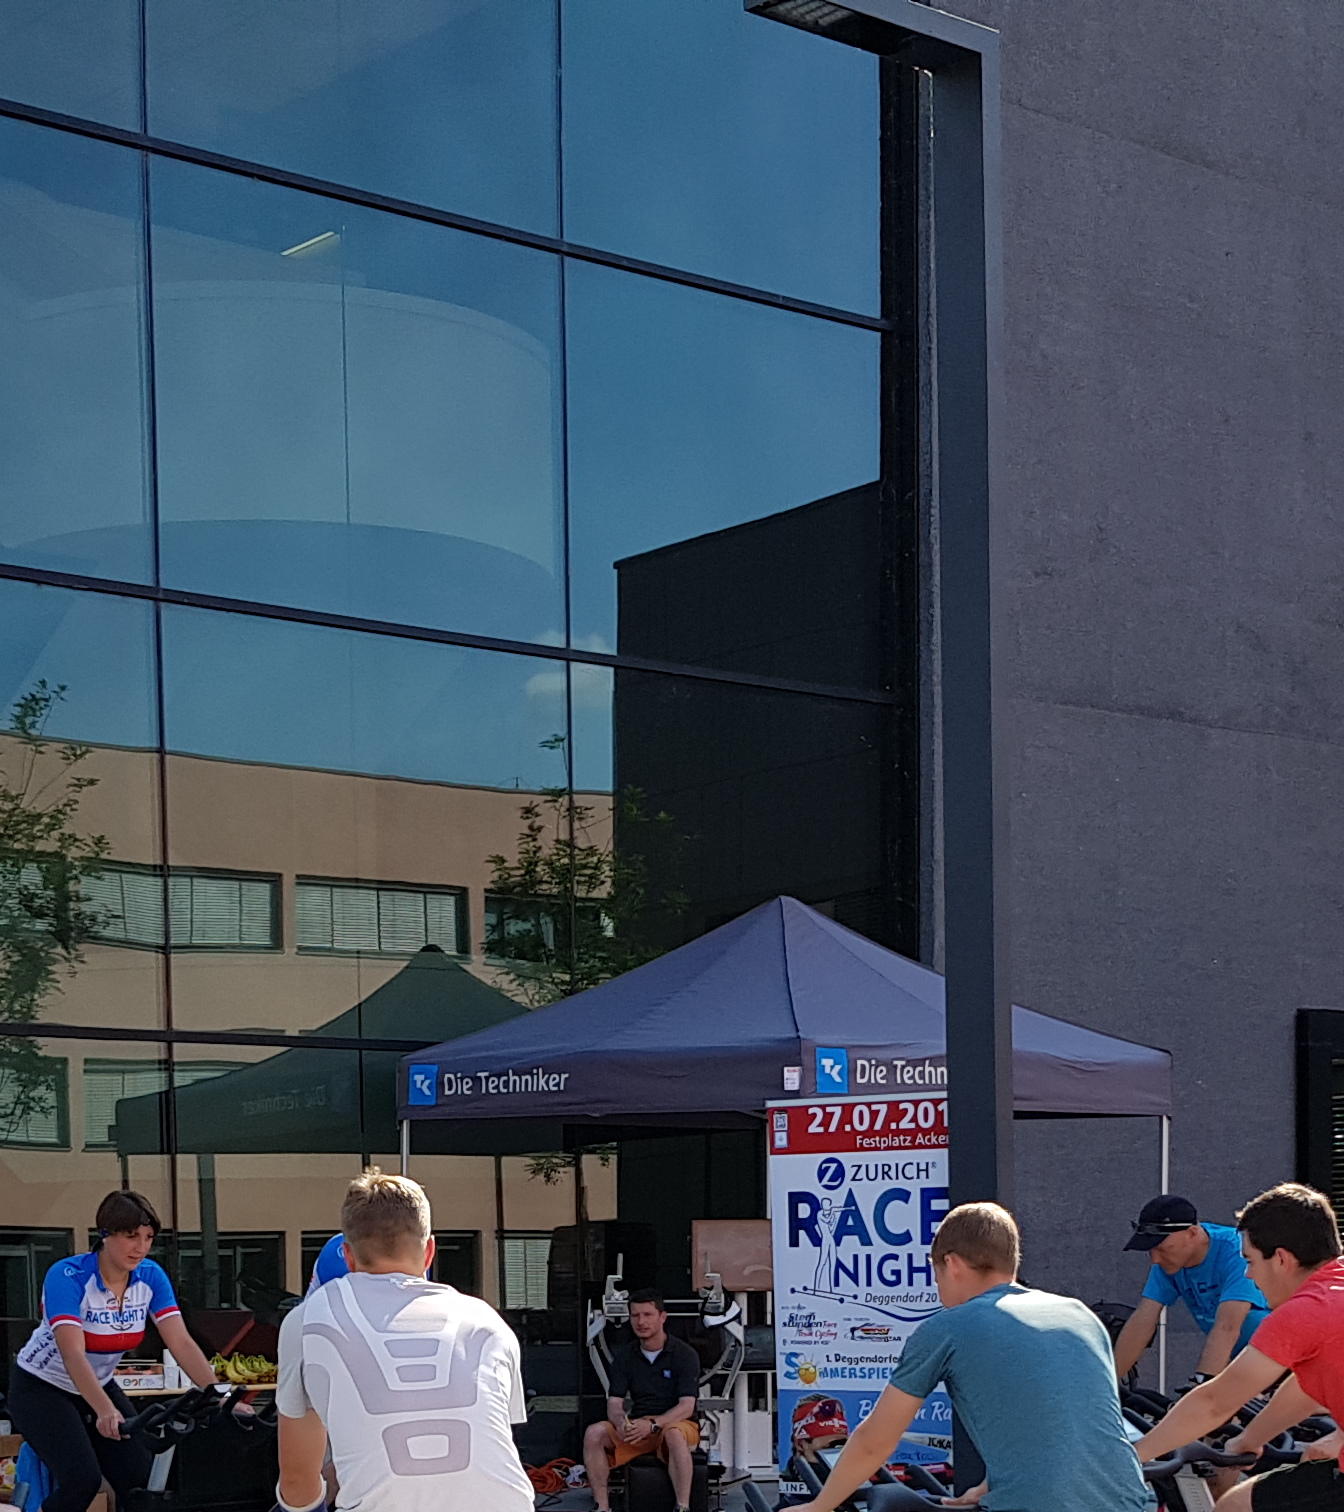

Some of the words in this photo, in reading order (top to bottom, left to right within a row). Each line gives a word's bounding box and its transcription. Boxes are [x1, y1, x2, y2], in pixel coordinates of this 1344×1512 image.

[444, 1072, 473, 1096] Die
[476, 1067, 569, 1094] Techniker
[856, 1059, 887, 1084] Die
[893, 1059, 948, 1085] Techn
[808, 1101, 948, 1133] 27.07.201
[856, 1135, 912, 1149] Festplatz
[787, 1187, 949, 1248] RACE
[833, 1253, 931, 1288] NIGH
[864, 1292, 924, 1306] Deggendorf
[925, 1292, 939, 1303] 20
[85, 1310, 111, 1324] RACE
[112, 1309, 138, 1324] NIGHT
[834, 1353, 899, 1365] Deggendorfe
